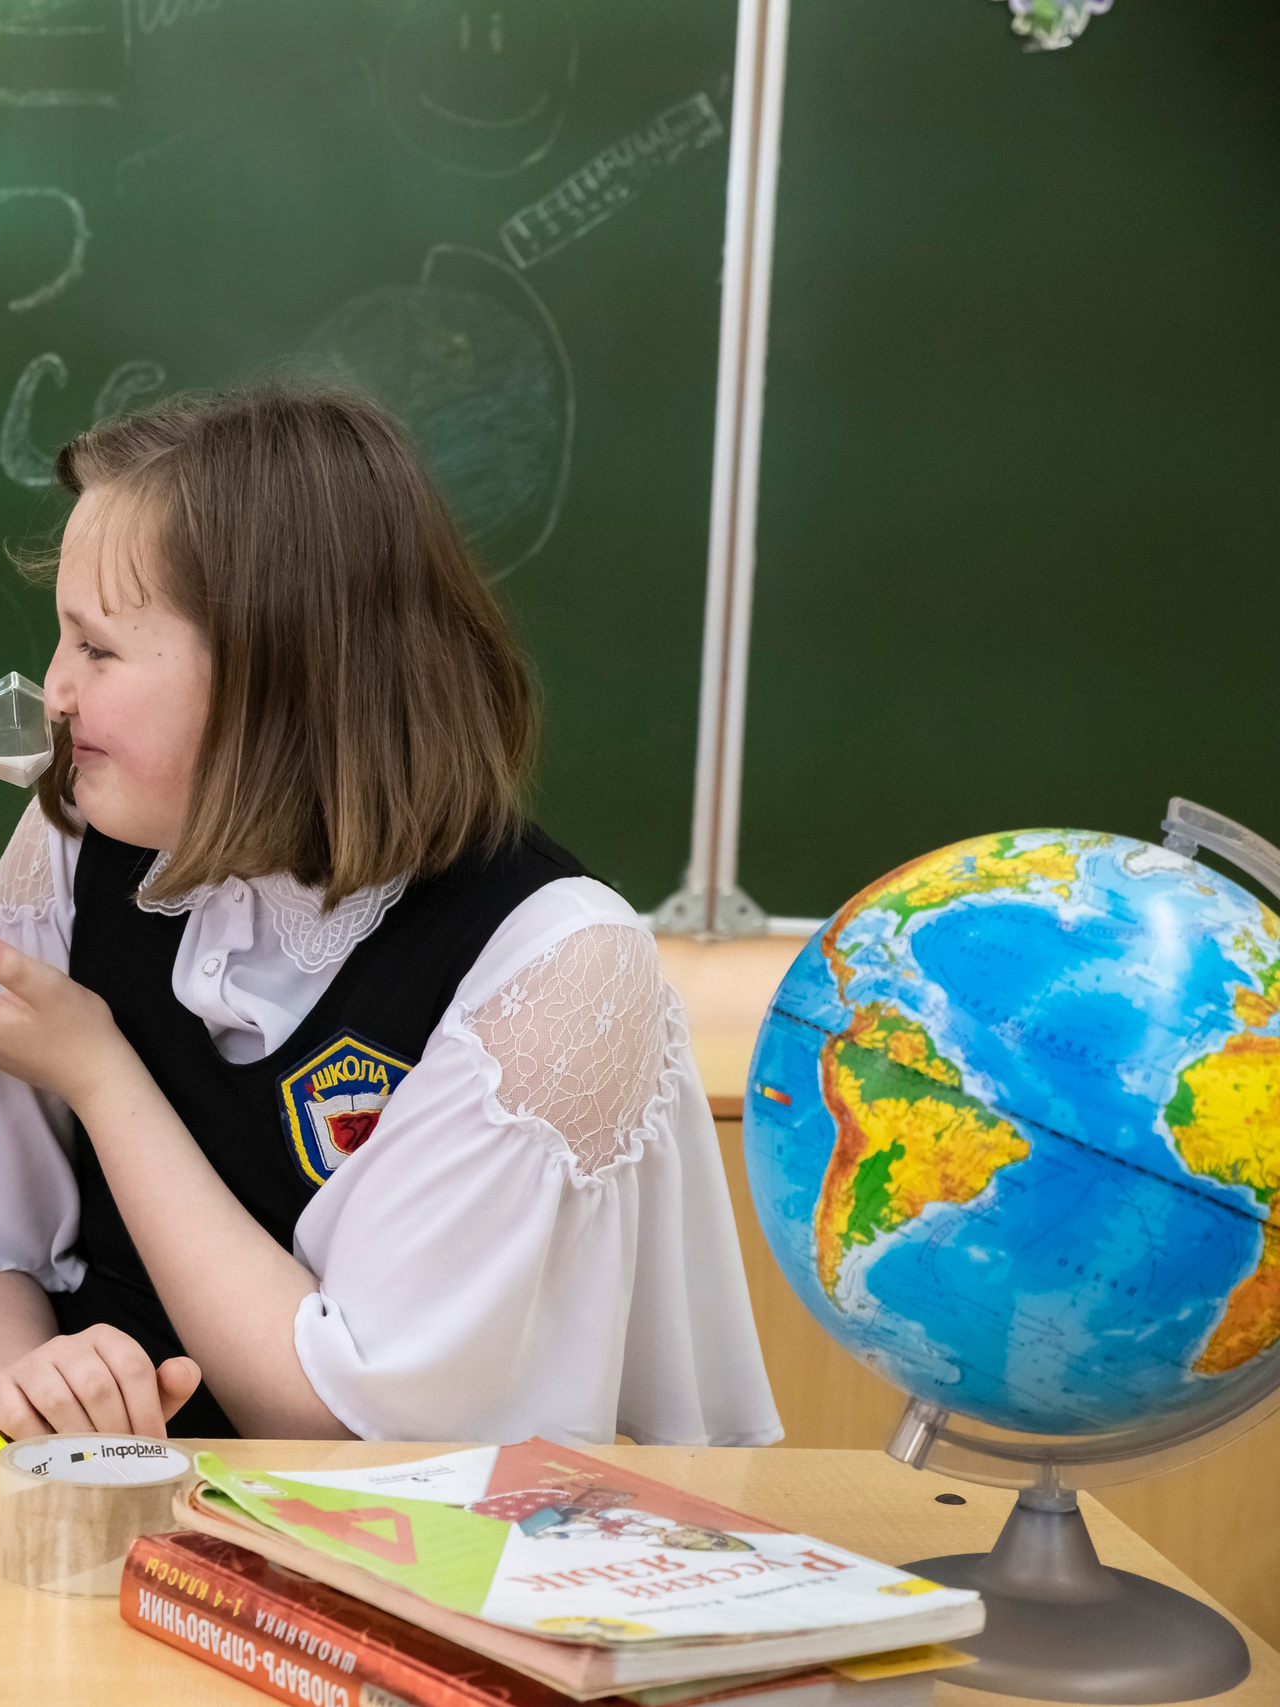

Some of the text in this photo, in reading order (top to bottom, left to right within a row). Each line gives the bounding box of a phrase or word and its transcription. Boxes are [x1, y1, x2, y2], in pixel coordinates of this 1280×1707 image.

[311, 1055, 389, 1090] ШКОЛА
[262, 1497, 418, 1566] 4
[614, 1549, 858, 1600] Русский
[138, 1588, 349, 1707] СЛОВАРЬ-СПРАВОЧНИК
[144, 1556, 358, 1675] ШКОЛЬНИКА 1-4 КЛАССЫ
